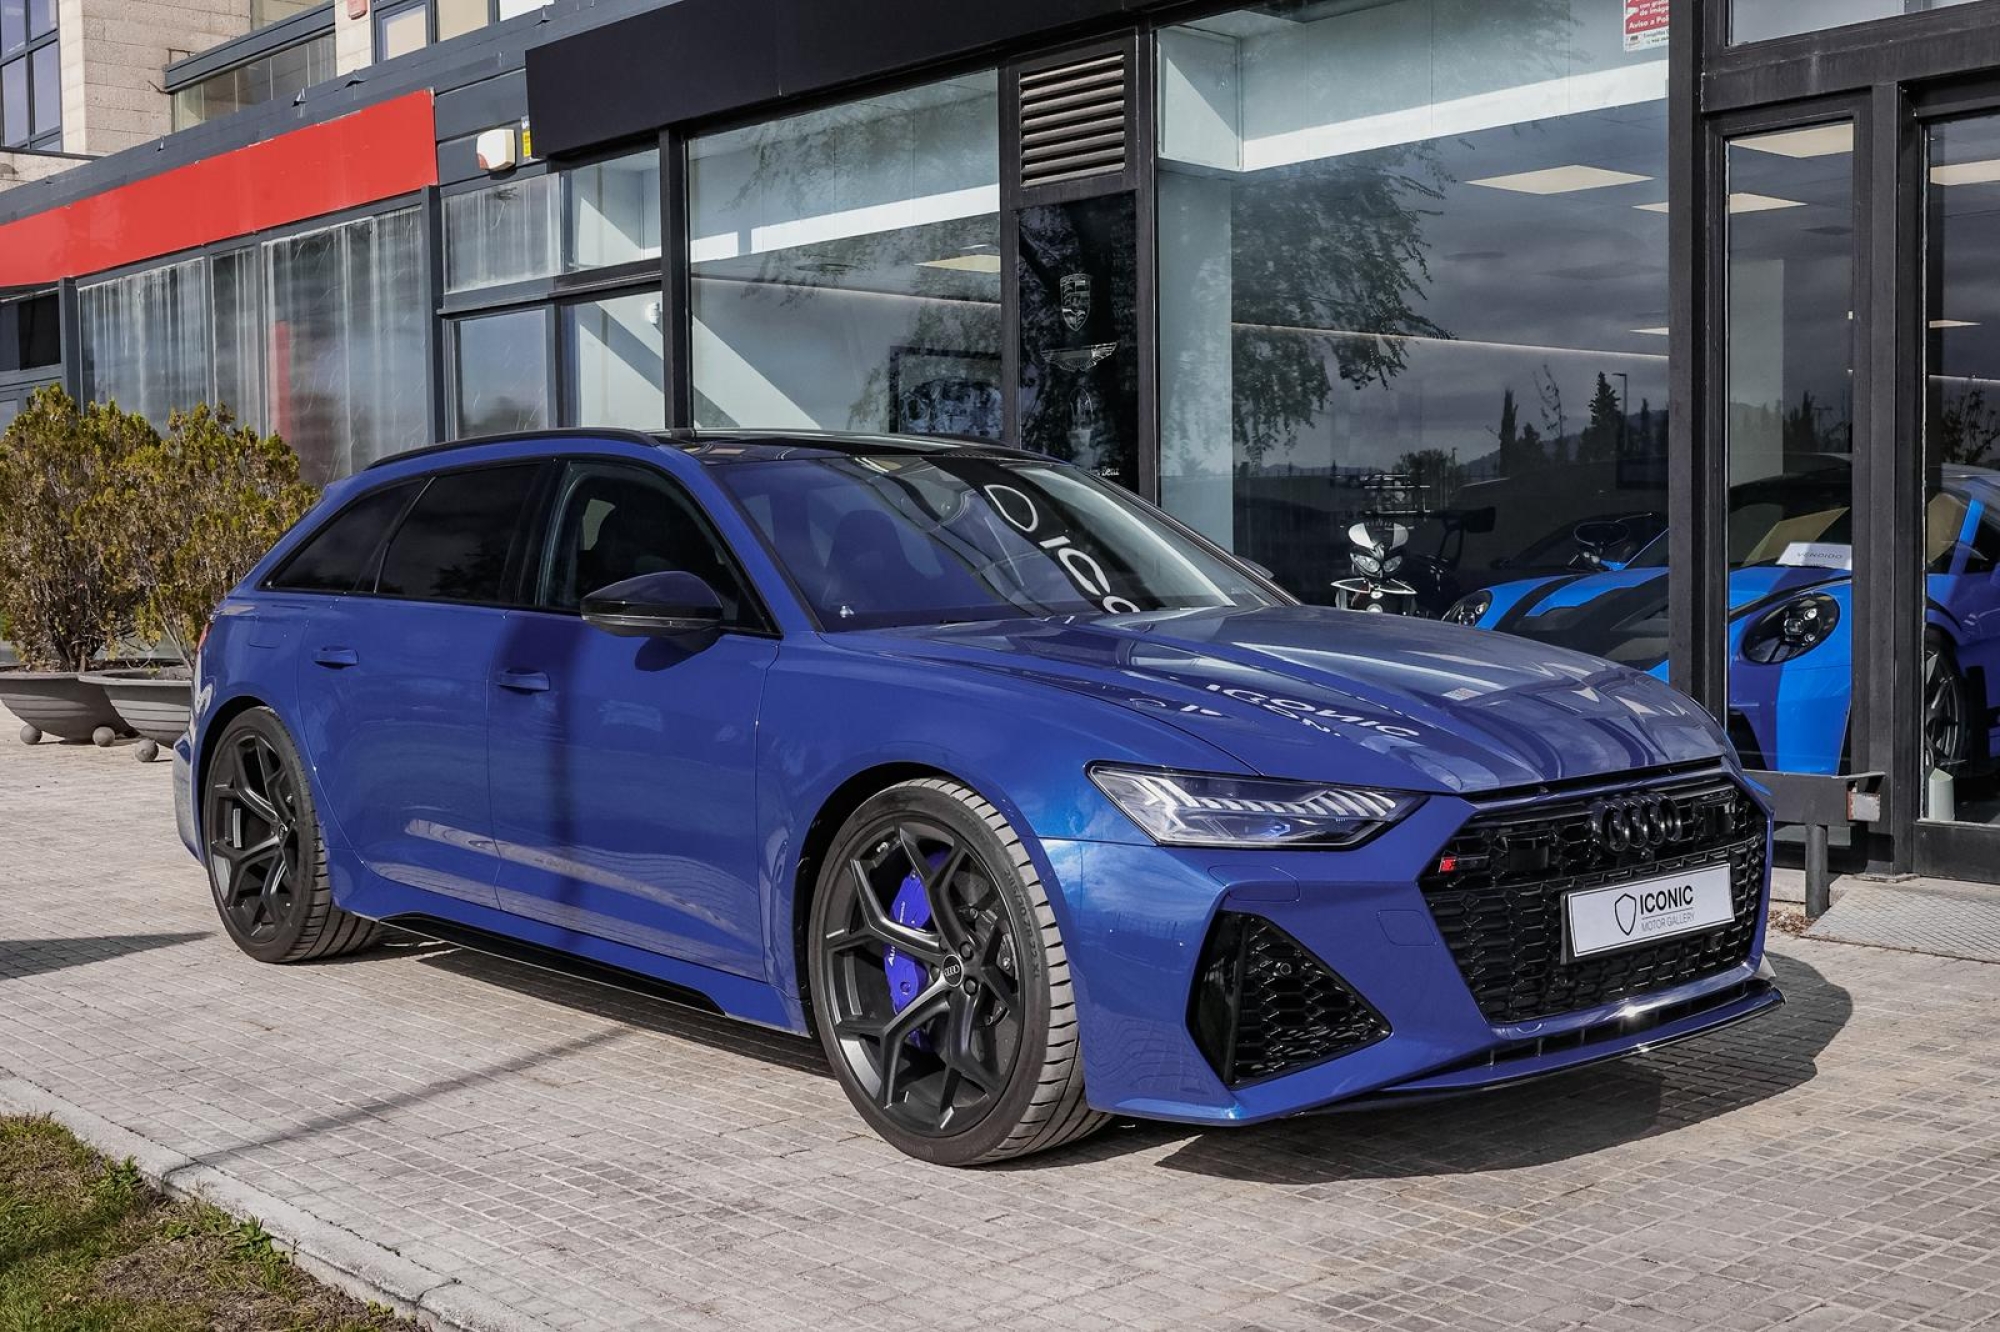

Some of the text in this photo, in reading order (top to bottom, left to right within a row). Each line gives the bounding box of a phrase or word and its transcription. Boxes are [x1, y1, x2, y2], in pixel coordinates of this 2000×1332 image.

[1628, 19, 1649, 30] Aviso
[1640, 885, 1694, 915] ICONIC
[1641, 911, 1696, 932] MOTOR GALLERY
